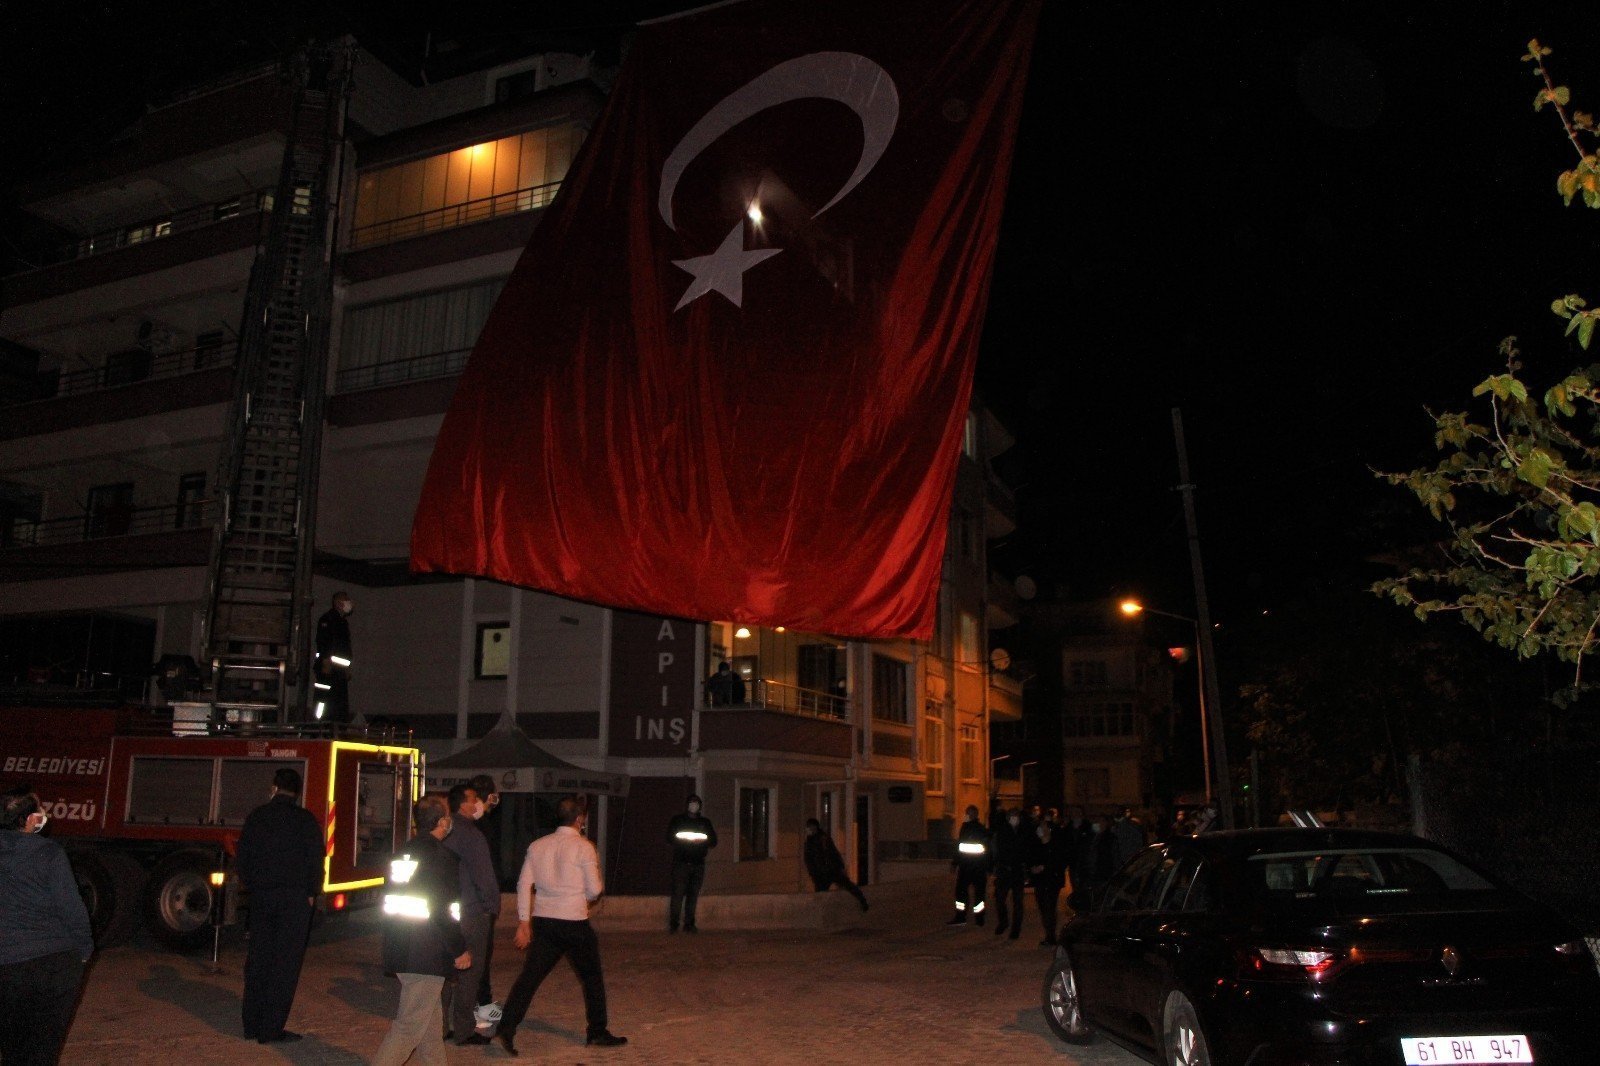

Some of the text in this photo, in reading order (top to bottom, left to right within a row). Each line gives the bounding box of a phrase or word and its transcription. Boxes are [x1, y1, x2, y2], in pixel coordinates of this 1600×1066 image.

[657, 619, 675, 706] API
[3, 756, 106, 775] BELEDİYESİ
[42, 795, 97, 820] ZÖZÜ
[1417, 1039, 1521, 1061] 61 BH 947
